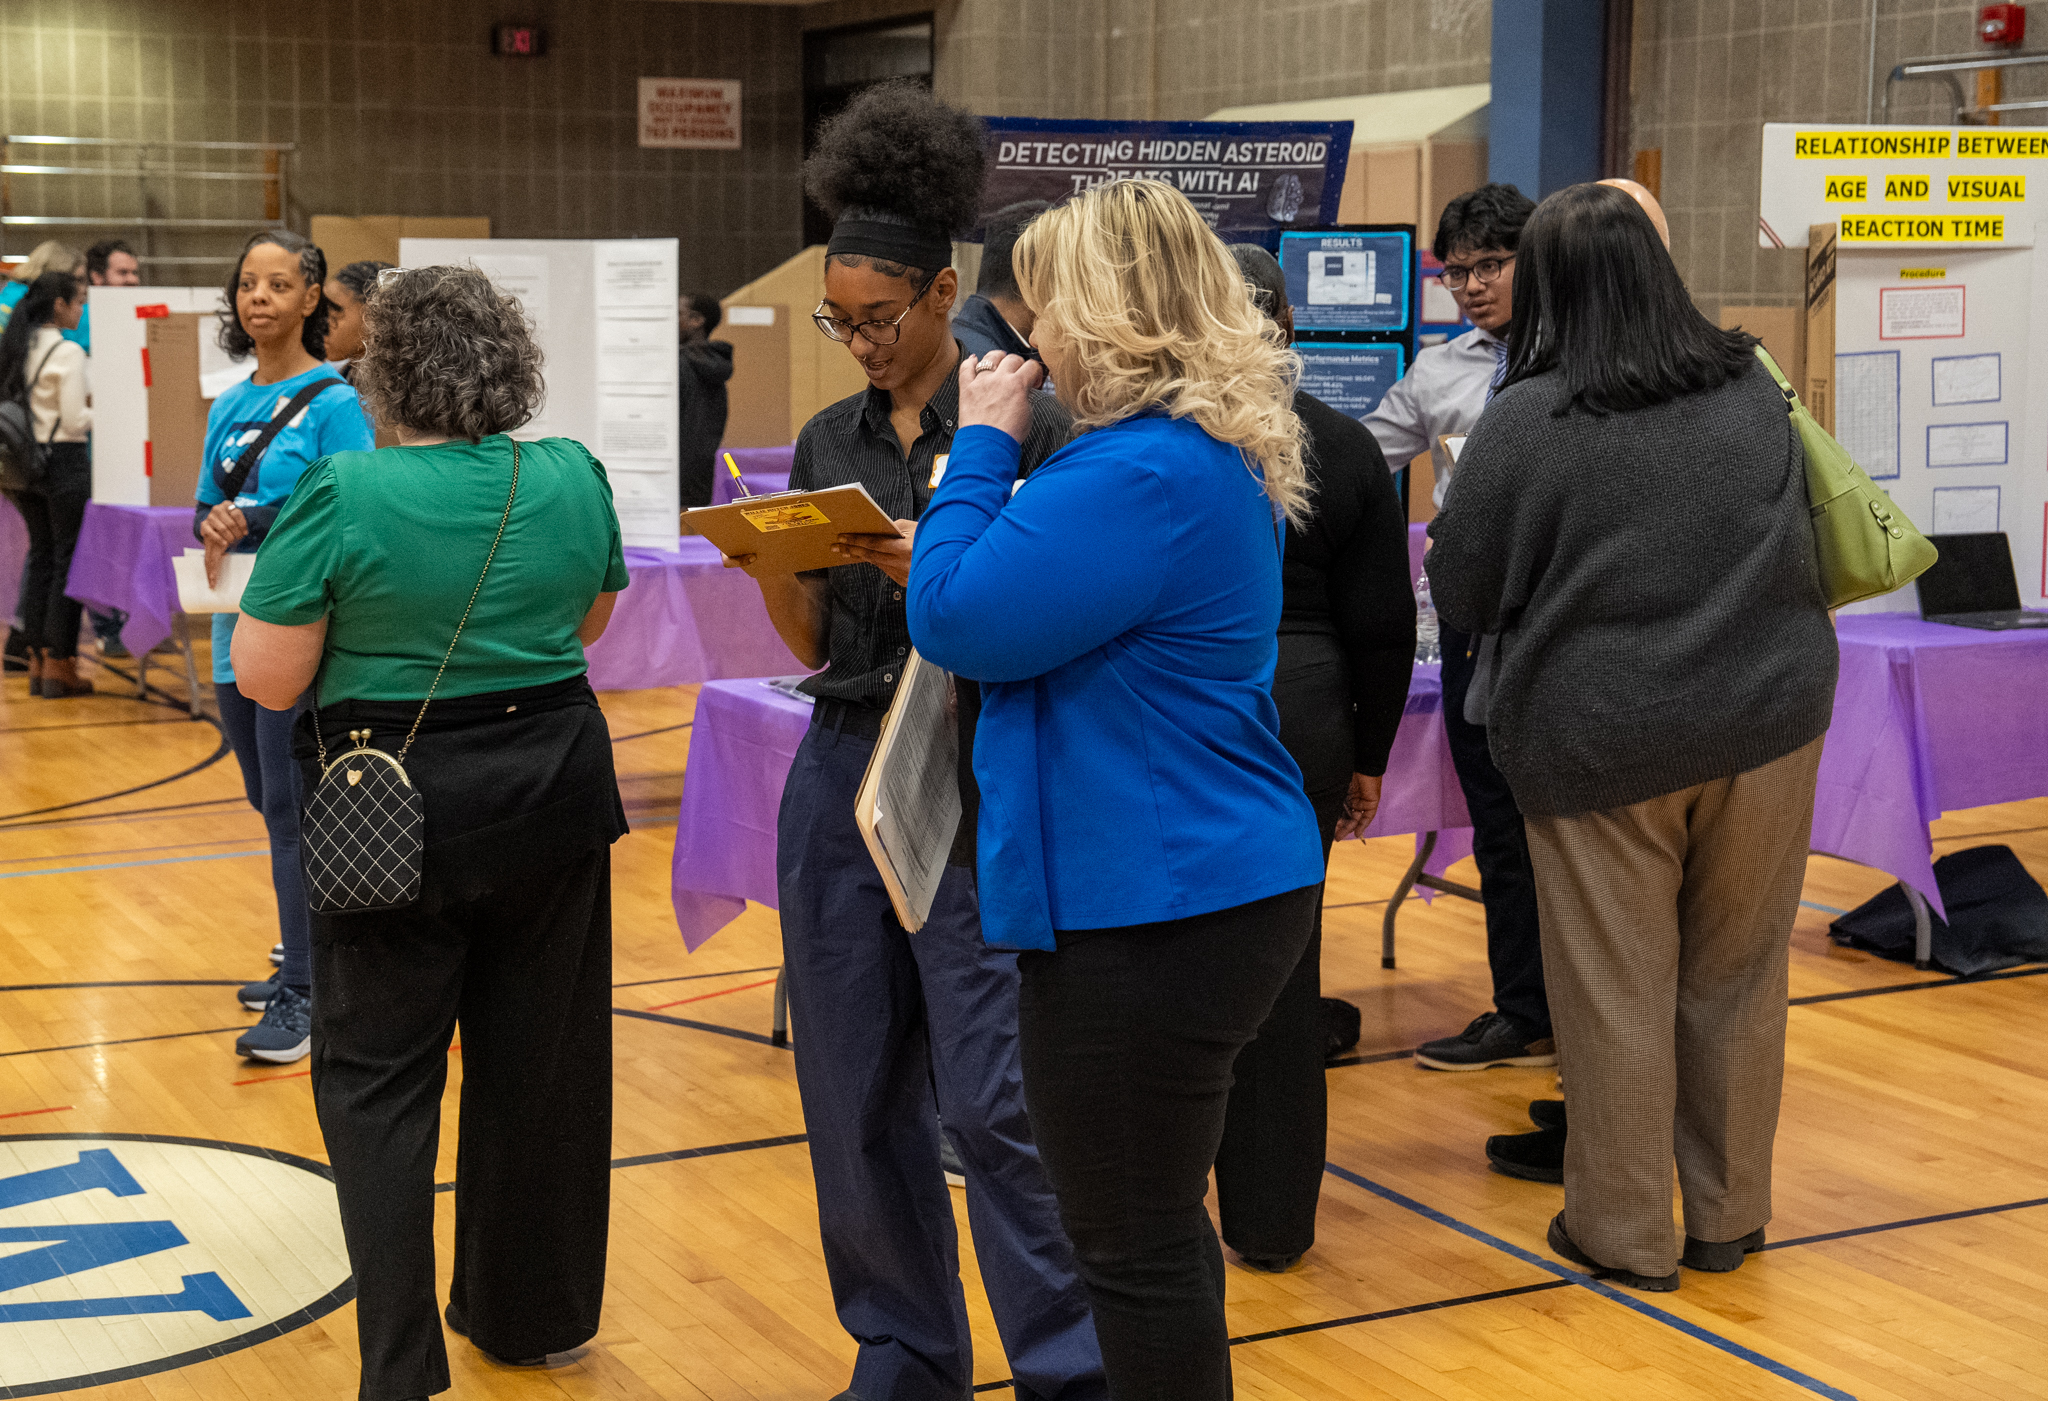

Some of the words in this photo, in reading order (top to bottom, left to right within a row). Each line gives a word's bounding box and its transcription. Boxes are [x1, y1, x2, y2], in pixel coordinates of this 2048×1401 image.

[656, 86, 723, 98] MAXIMUM
[648, 102, 731, 114] OCCUPANCY
[671, 126, 735, 139] PERSONS
[1795, 137, 1950, 154] RELATIONSHIP
[997, 140, 1133, 165] DETECTING
[1138, 140, 1222, 162] HIDDEN
[1222, 141, 1327, 163] ASTEROID
[1177, 170, 1234, 192] WITH
[1236, 171, 1260, 192] AI
[1826, 181, 1867, 198] AGE
[1885, 181, 1929, 198] AND
[1947, 181, 2025, 198] VISUAL
[1841, 220, 1944, 237] REACTION
[1951, 220, 2003, 237] TIME
[1321, 238, 1363, 248] RESULTS
[1900, 269, 1946, 278] Procedure
[1303, 354, 1350, 363] Performance
[1351, 354, 1379, 363] Metrics
